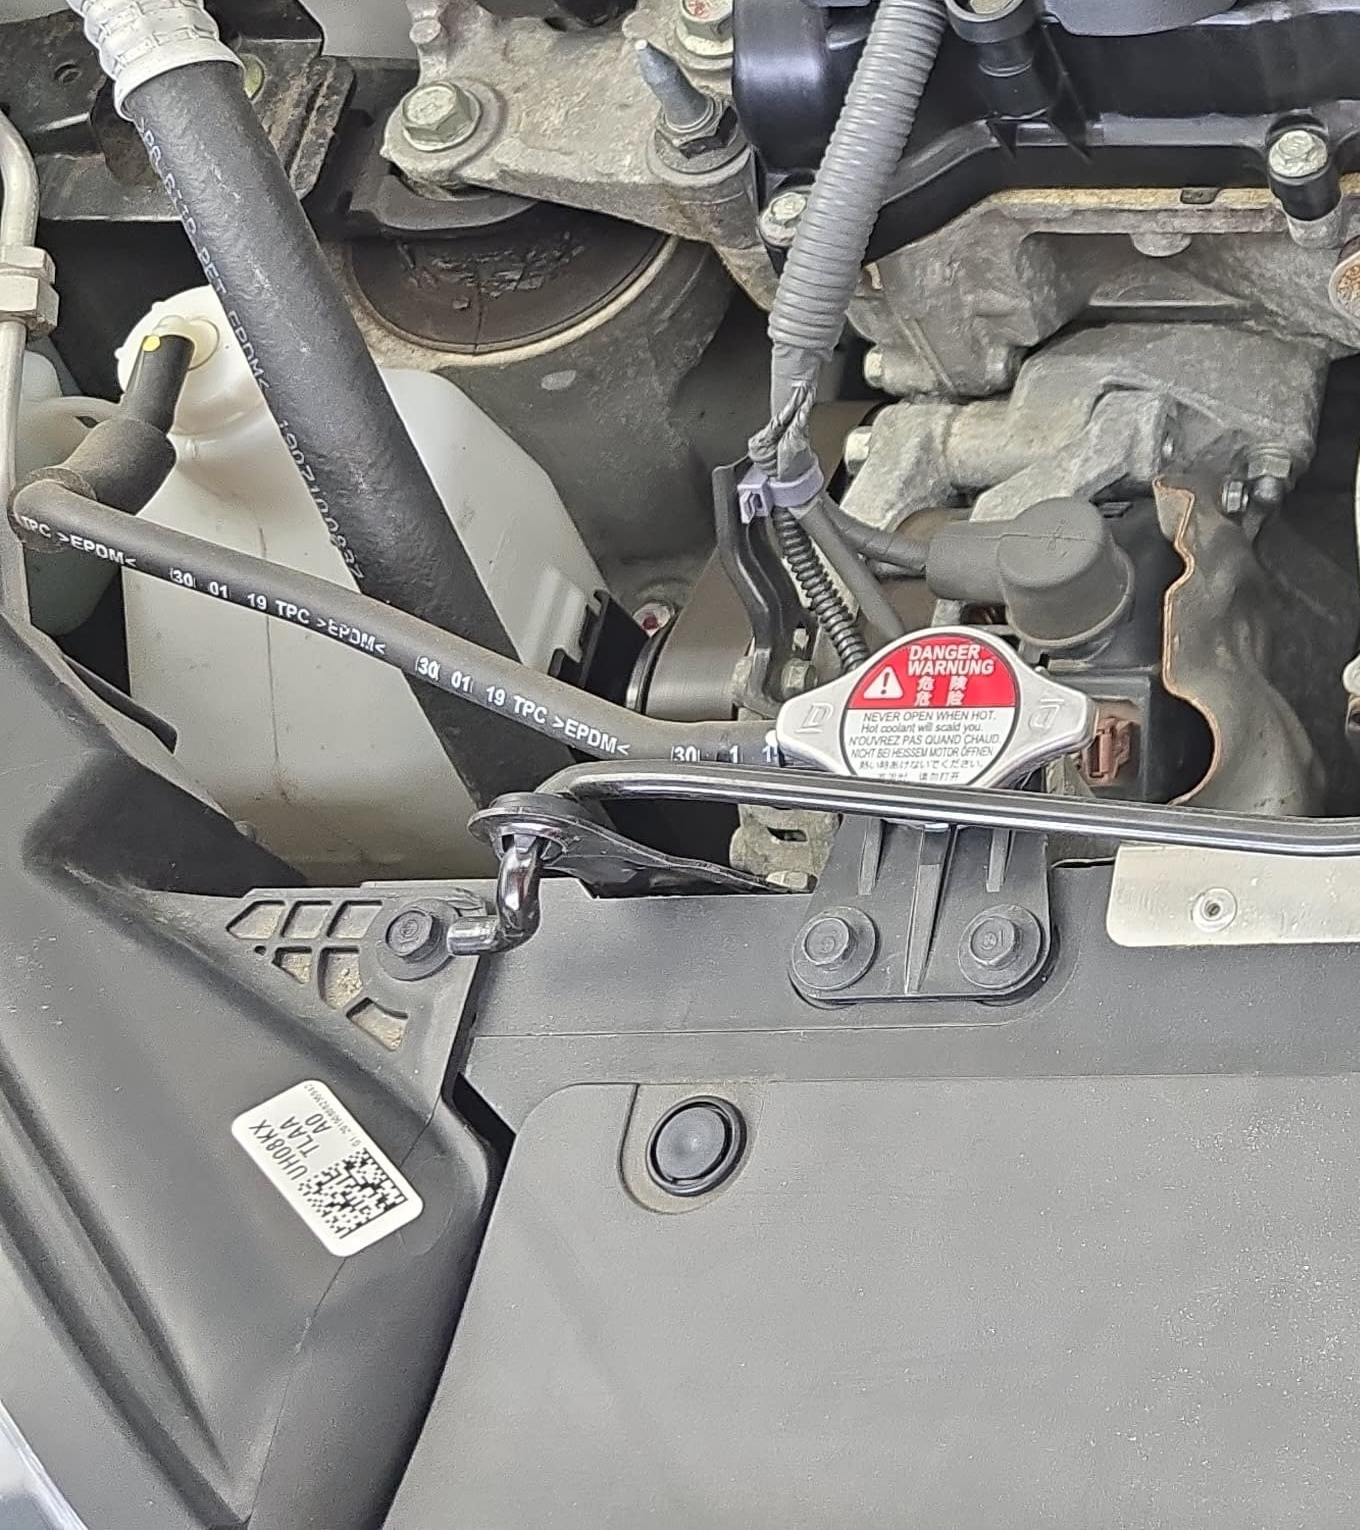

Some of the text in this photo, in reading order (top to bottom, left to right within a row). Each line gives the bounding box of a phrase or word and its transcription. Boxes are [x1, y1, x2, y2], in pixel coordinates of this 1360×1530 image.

[247, 592, 268, 611] 19
[275, 600, 310, 626] TPC
[908, 644, 981, 660] DANGER
[907, 659, 995, 677] WARNUNG
[485, 684, 506, 707] 19
[512, 695, 548, 725] TPC
[863, 710, 997, 722] NEVER OPEN WHEN HOT.
[861, 724, 879, 734] Hot
[880, 723, 916, 733] coolant
[917, 723, 933, 732] will
[935, 722, 961, 732] scald
[902, 735, 922, 745] PAS
[925, 734, 962, 745] QUAND
[929, 747, 959, 757] MOTOR
